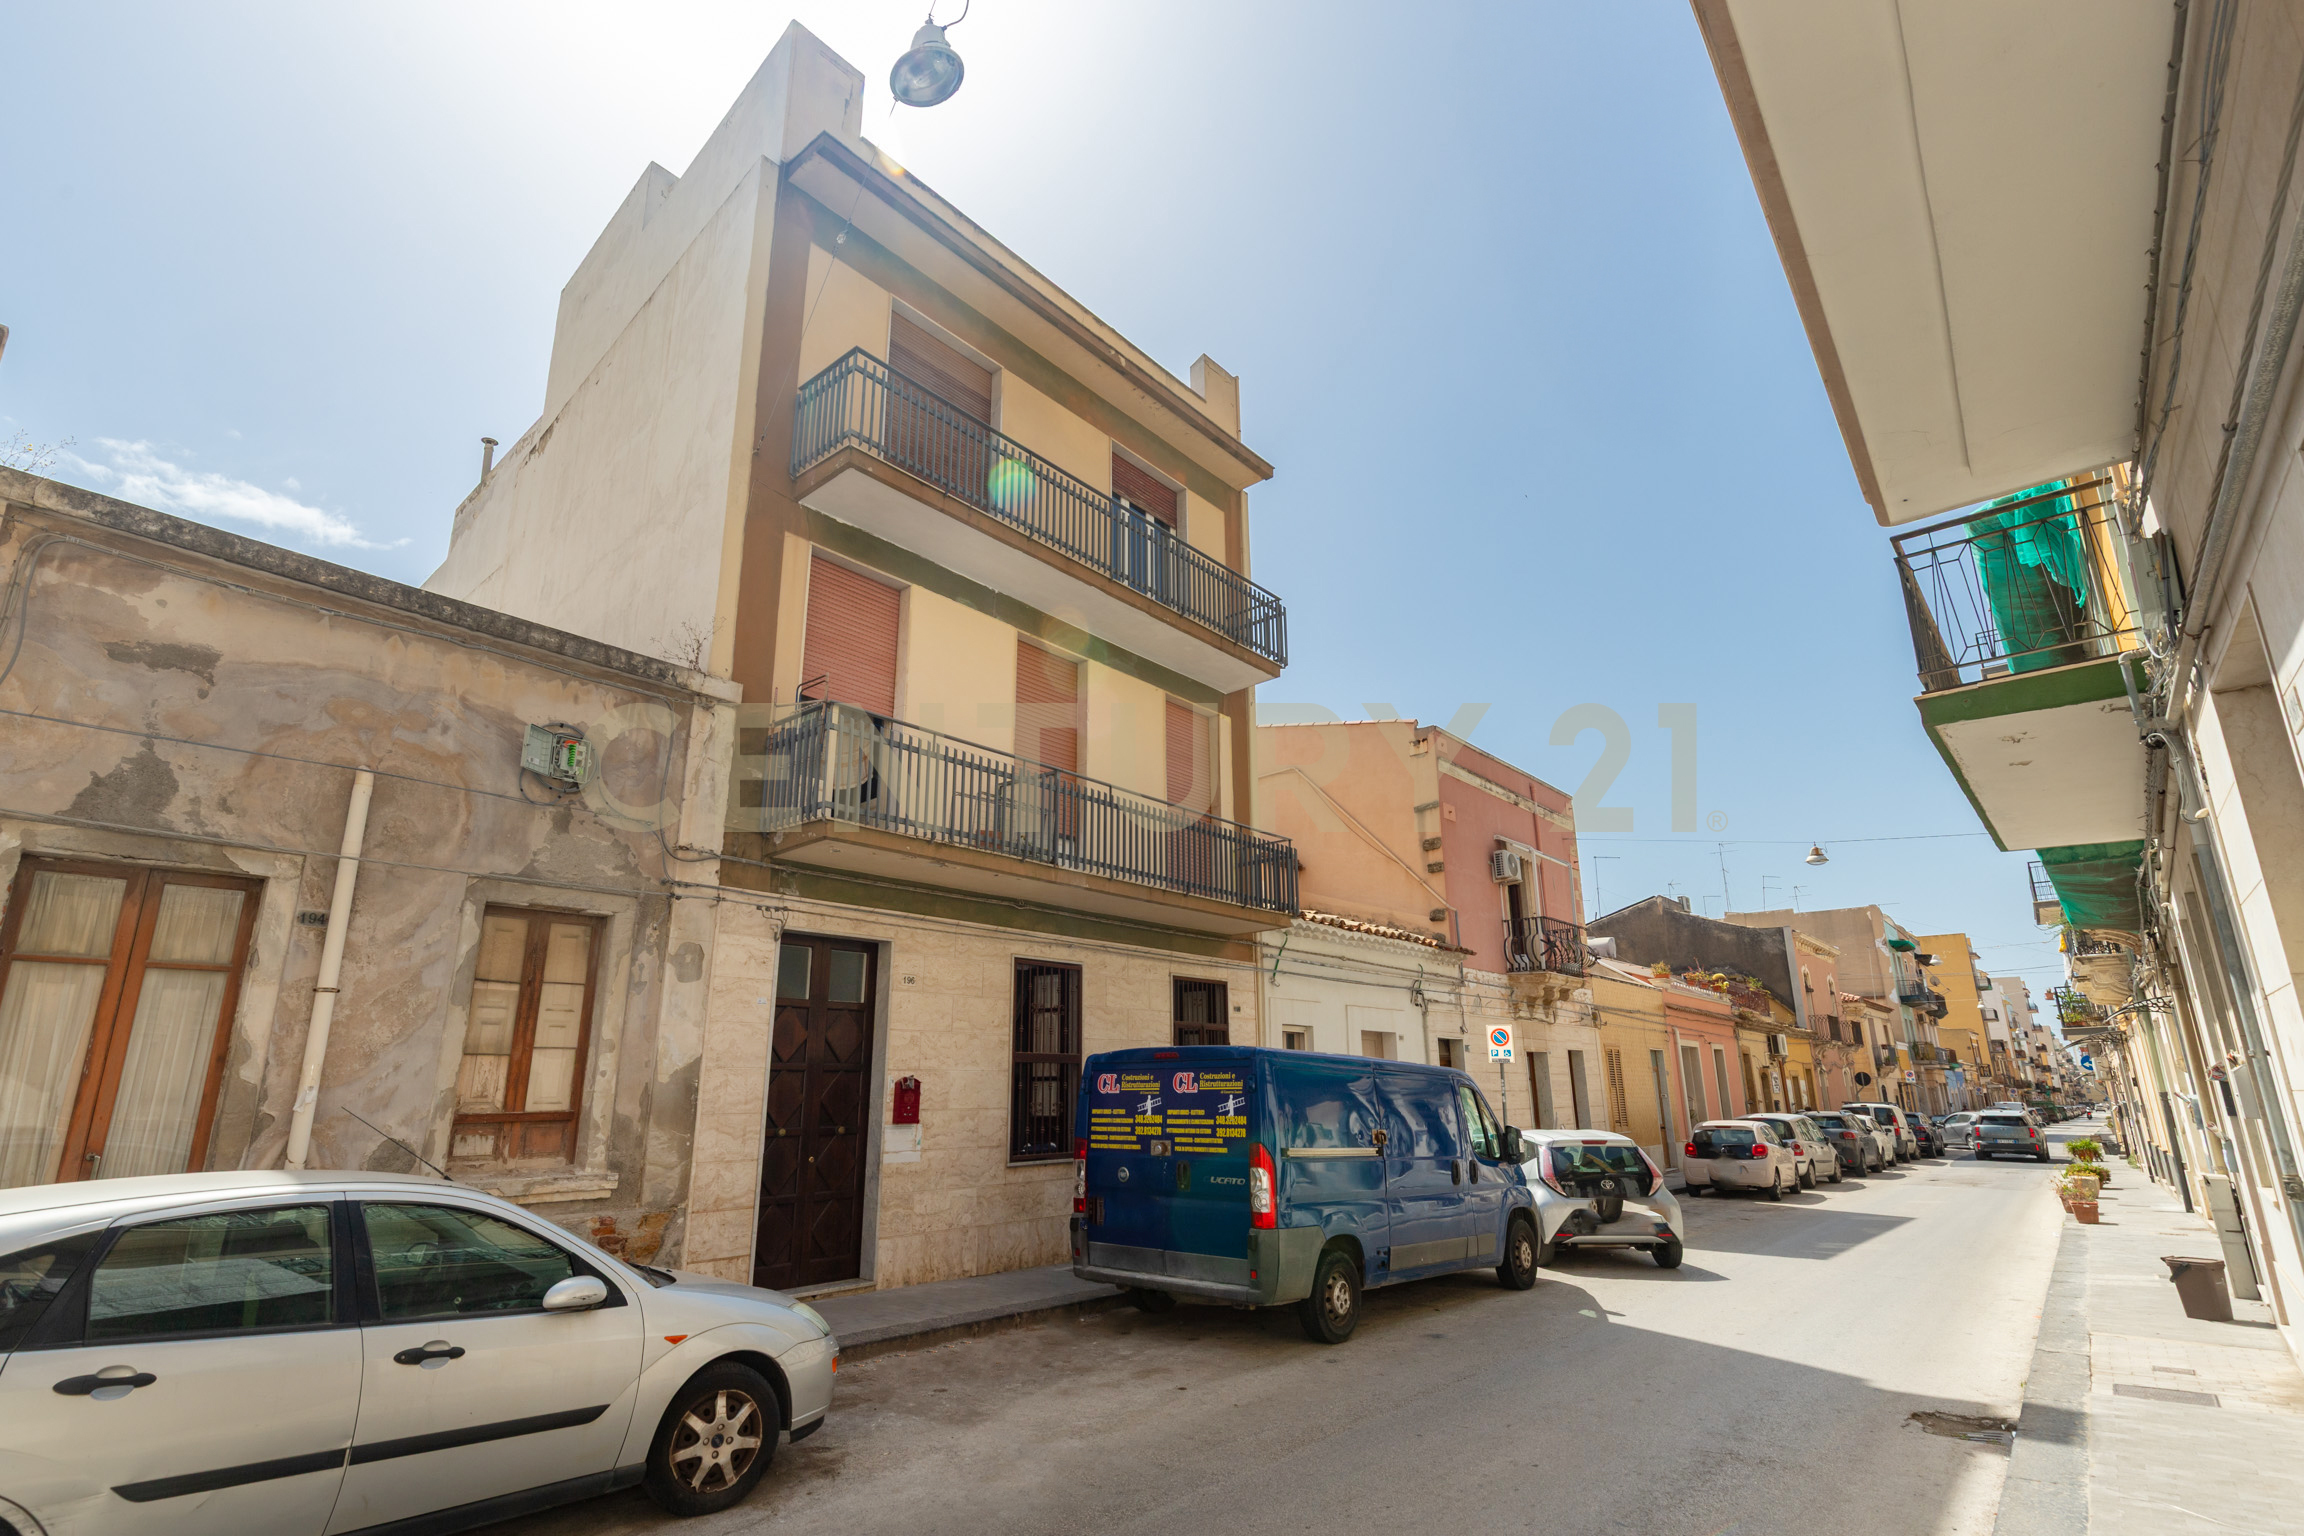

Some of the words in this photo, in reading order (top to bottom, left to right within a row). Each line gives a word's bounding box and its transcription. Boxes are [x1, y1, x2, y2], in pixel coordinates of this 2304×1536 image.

[903, 975, 916, 985] 196
[1098, 1073, 1120, 1094] CL
[1121, 1073, 1150, 1081] Costruzioni
[1173, 1072, 1198, 1093] CL
